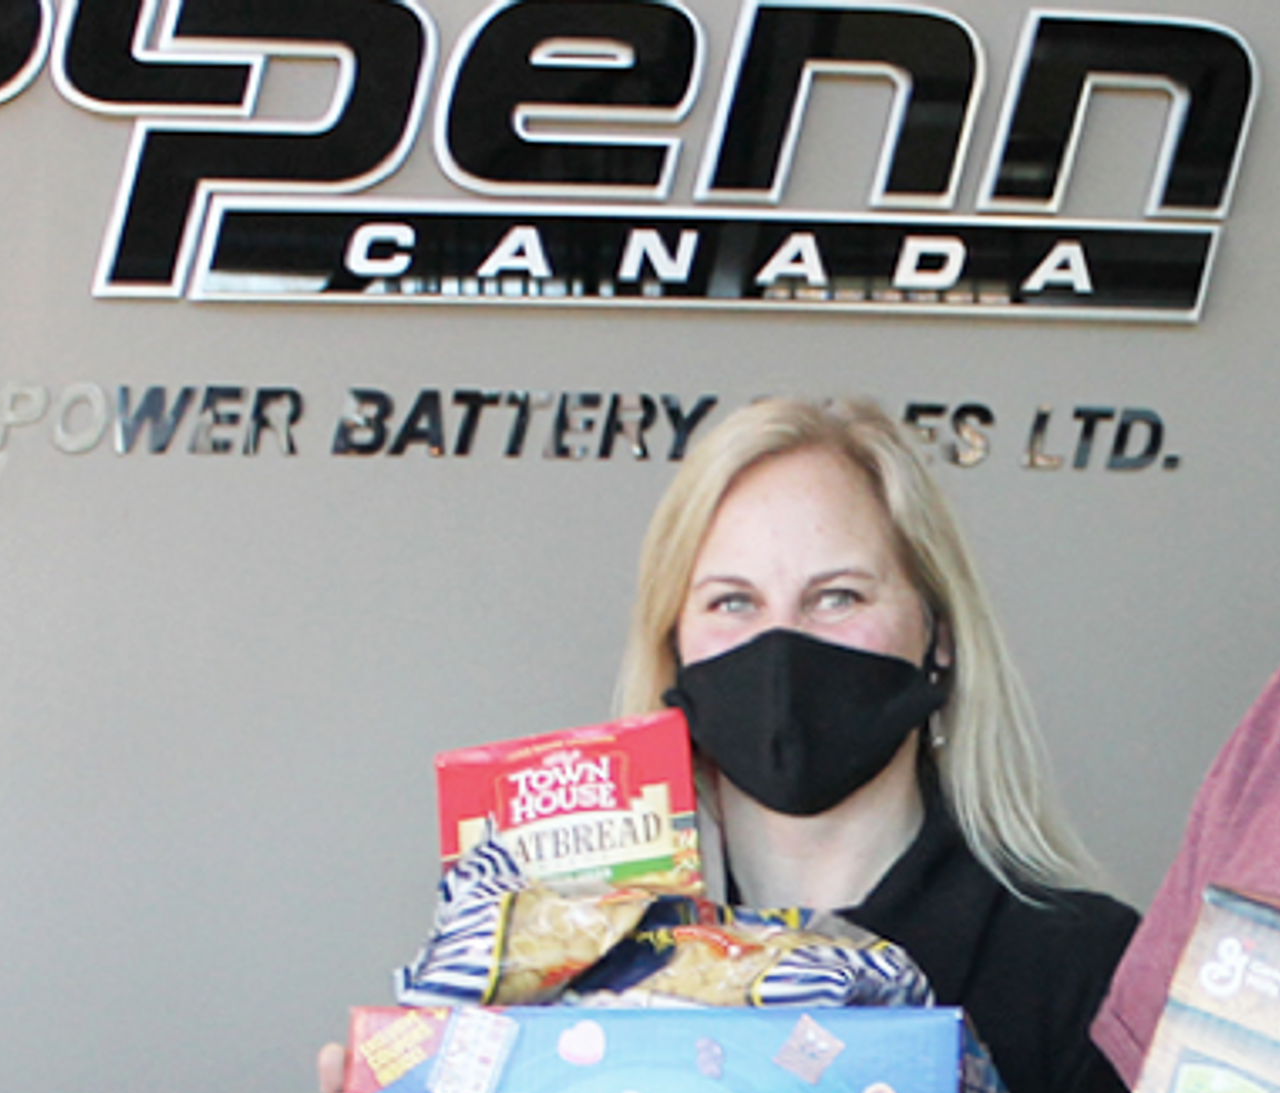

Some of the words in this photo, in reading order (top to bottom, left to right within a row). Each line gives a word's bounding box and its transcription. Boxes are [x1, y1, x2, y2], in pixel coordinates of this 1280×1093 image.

[343, 222, 1096, 294] CANADA
[330, 387, 718, 462] BATTERY
[1023, 402, 1183, 472] LTD.
[507, 755, 611, 798] TOWN
[510, 782, 617, 824] HOUSE
